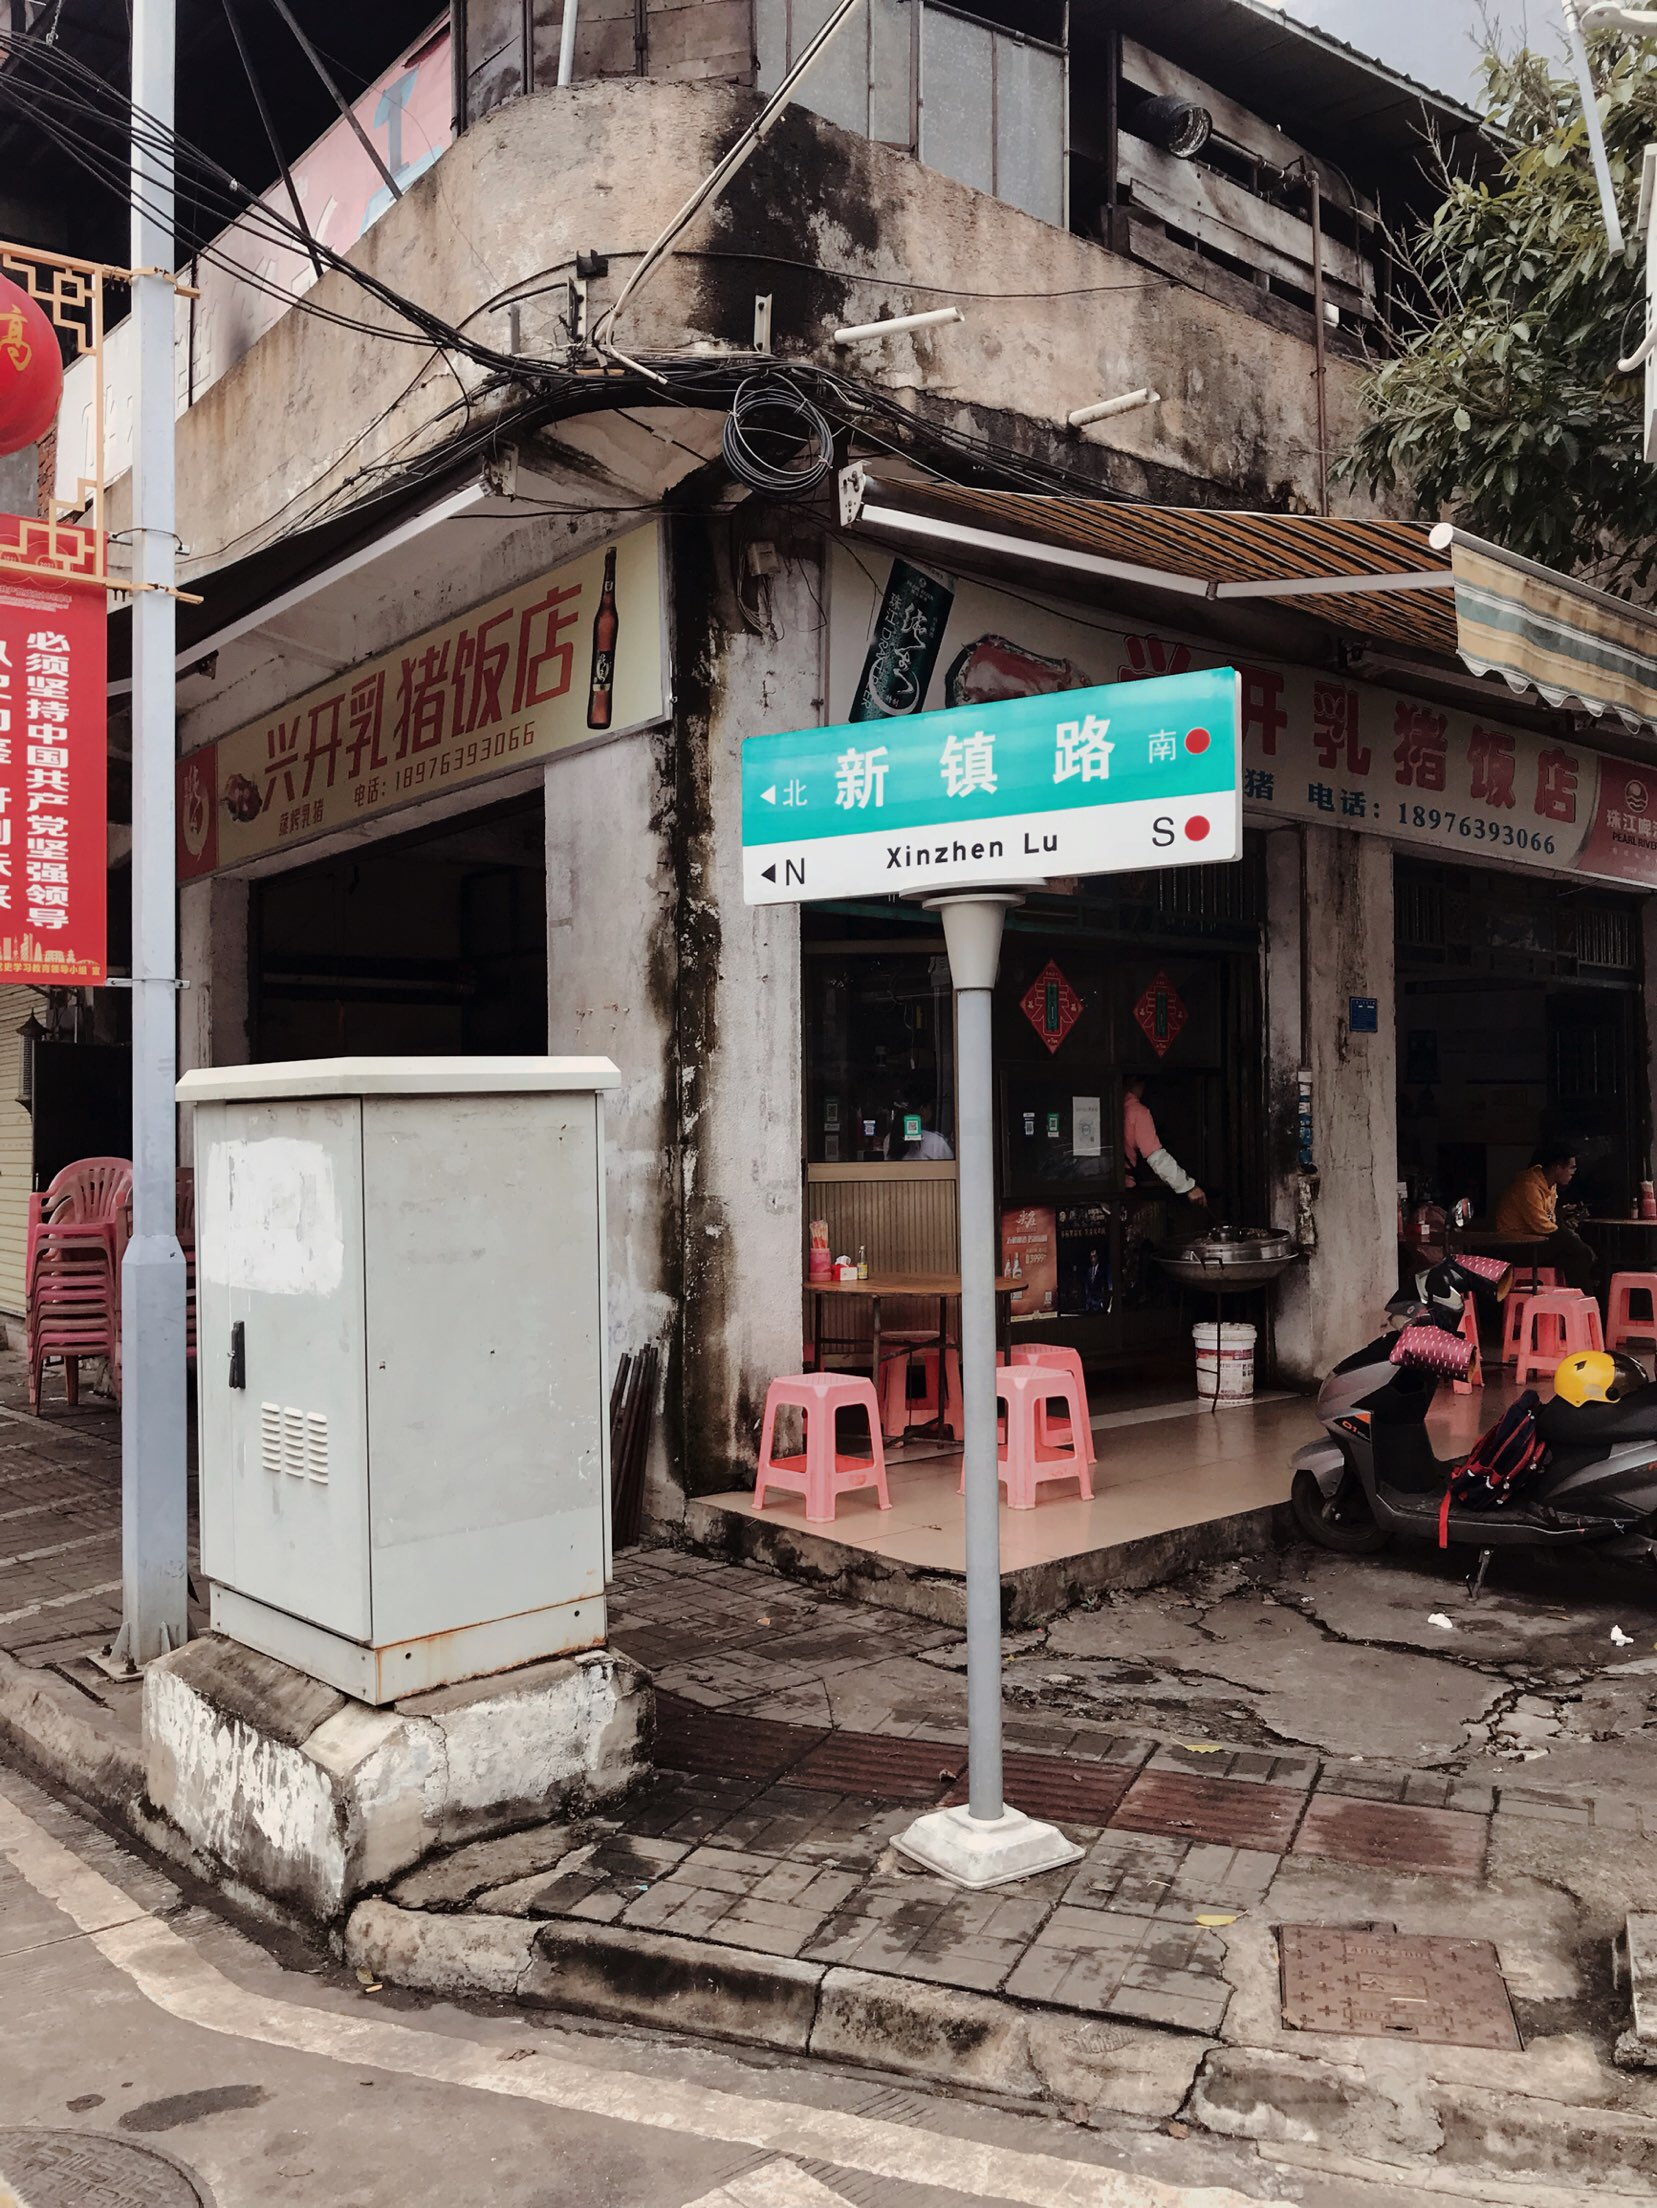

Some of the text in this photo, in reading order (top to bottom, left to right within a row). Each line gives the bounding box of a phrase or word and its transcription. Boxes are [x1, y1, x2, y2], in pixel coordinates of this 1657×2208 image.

[262, 583, 582, 813] 兴开乳猪饭店
[25, 630, 71, 930] 必须坚持中国共产党坚强领导
[395, 720, 536, 793] 18976393066
[782, 714, 1177, 811] 北 新镇路 南
[785, 816, 1176, 887] N Xinzhen Lu S
[1398, 801, 1556, 856] 18976393066
[0, 961, 87, 976] 史学习教育领导小组
